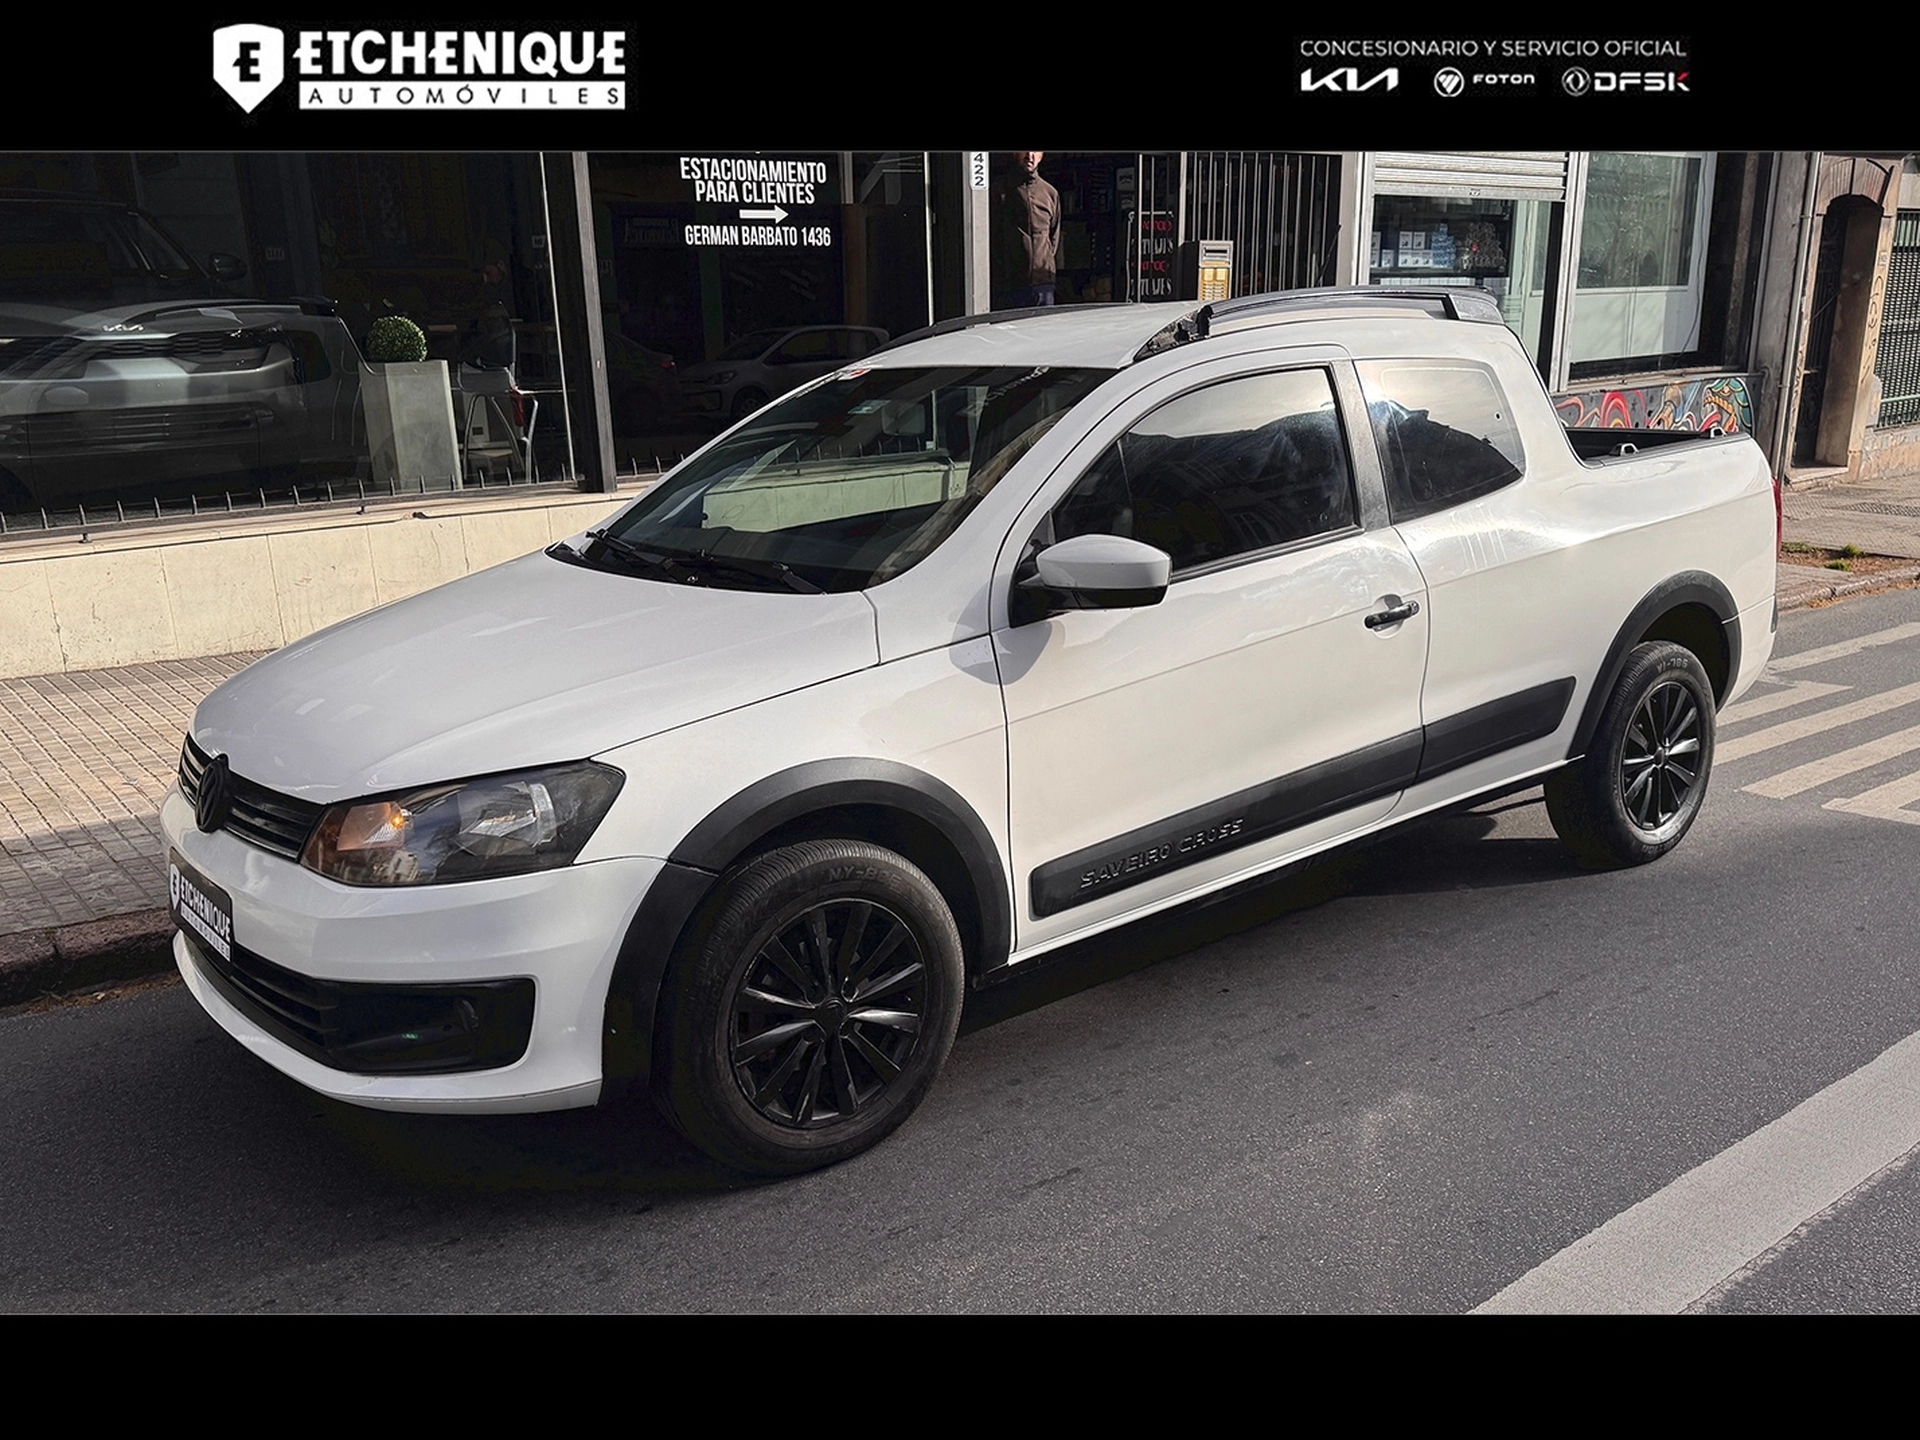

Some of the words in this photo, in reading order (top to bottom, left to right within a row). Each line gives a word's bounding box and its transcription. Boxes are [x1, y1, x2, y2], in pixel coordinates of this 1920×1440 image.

[680, 157, 827, 184] ESTACIONAMIENTO
[695, 181, 739, 203] PARA
[743, 183, 815, 205] CLIENTES
[685, 225, 739, 246] GERMAN
[742, 226, 797, 246] BARBATO
[801, 226, 831, 246] 1436
[1080, 843, 1173, 889] SAVEIRO
[1178, 819, 1244, 854] CROSS
[180, 875, 231, 943] ETCHENIQUE
